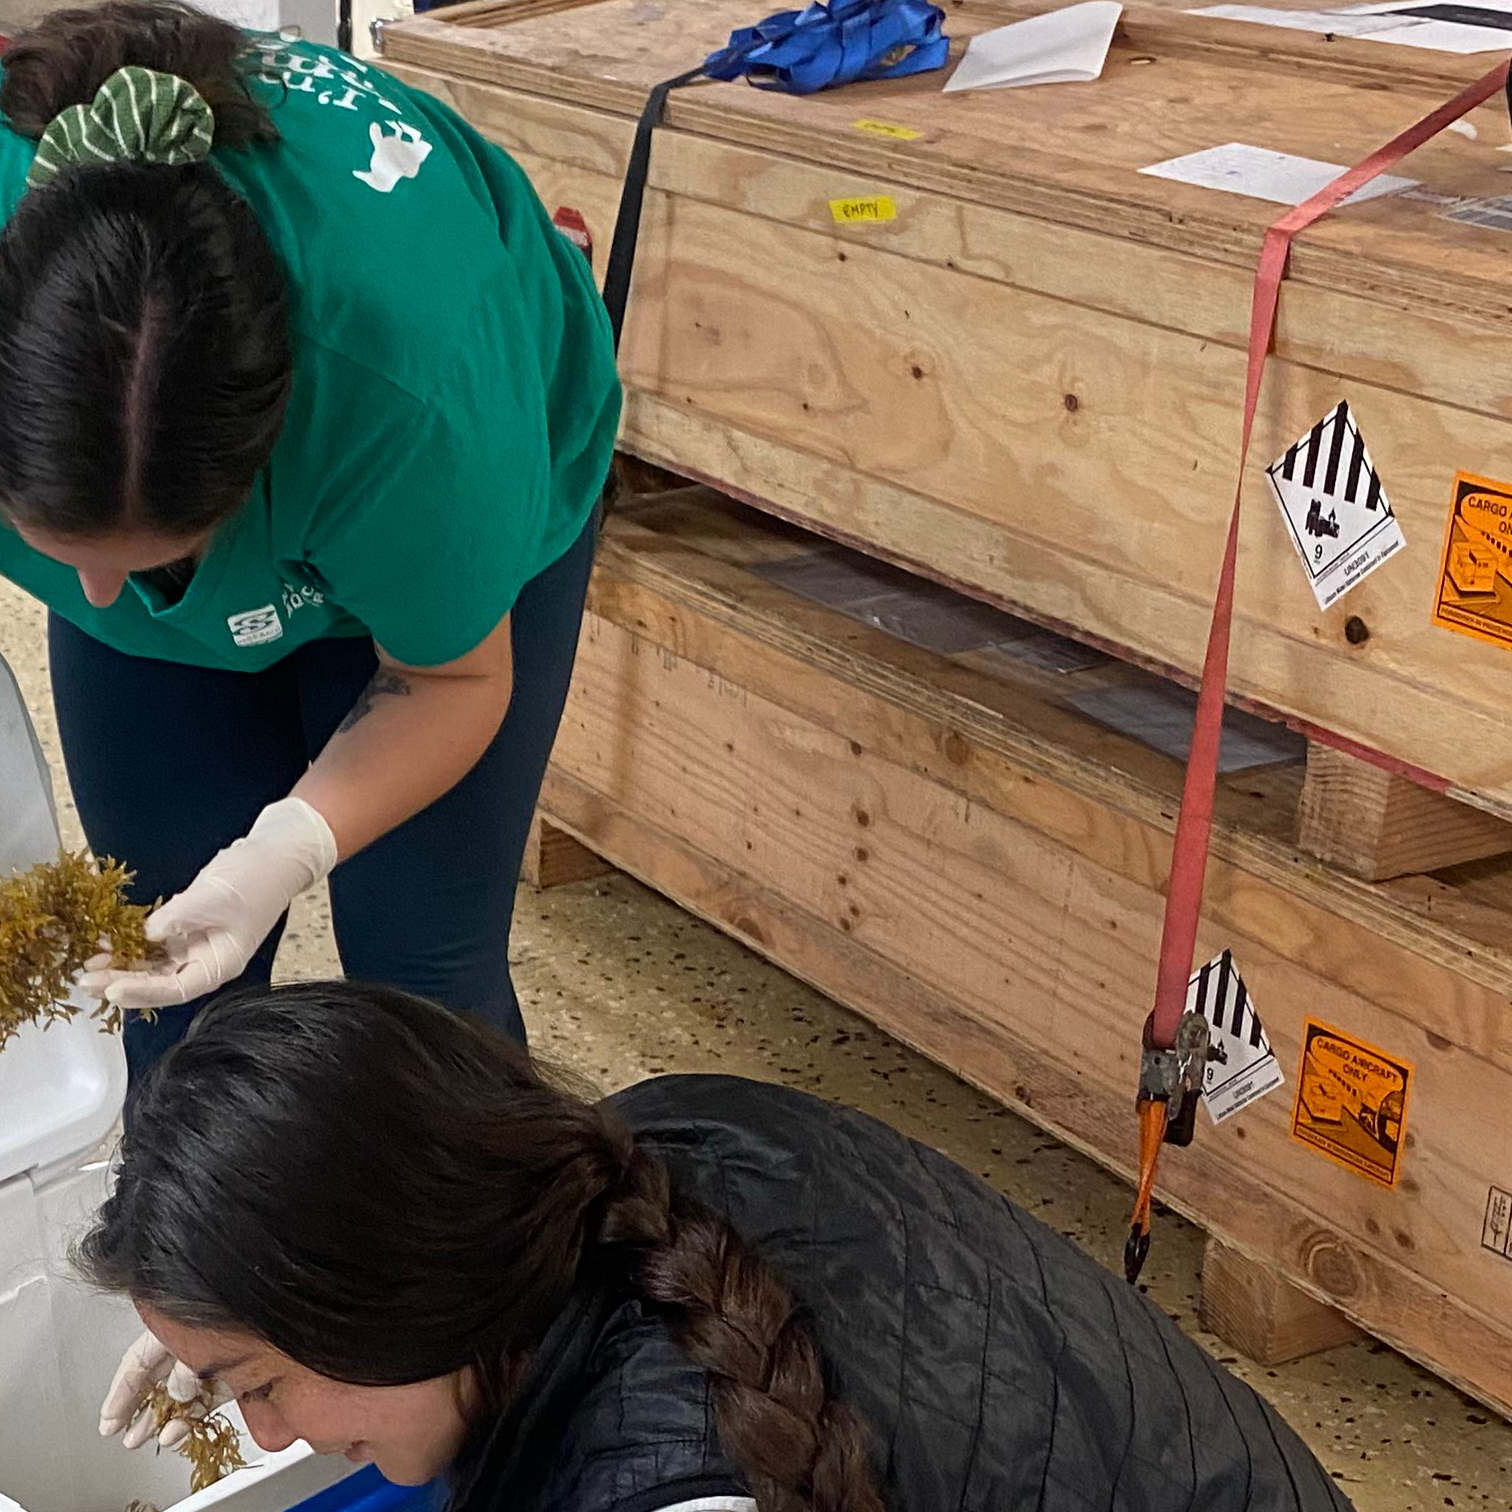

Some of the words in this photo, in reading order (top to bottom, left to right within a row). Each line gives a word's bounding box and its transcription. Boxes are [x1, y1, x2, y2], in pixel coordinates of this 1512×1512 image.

[843, 202, 878, 218] EMPTY
[1468, 496, 1507, 517] CARGO
[1315, 544, 1323, 560] 9
[1317, 1037, 1350, 1061] CARGO
[1351, 1055, 1398, 1084] AIRCRAFT
[1207, 1067, 1214, 1081] 9
[1343, 1064, 1369, 1082] ONLY
